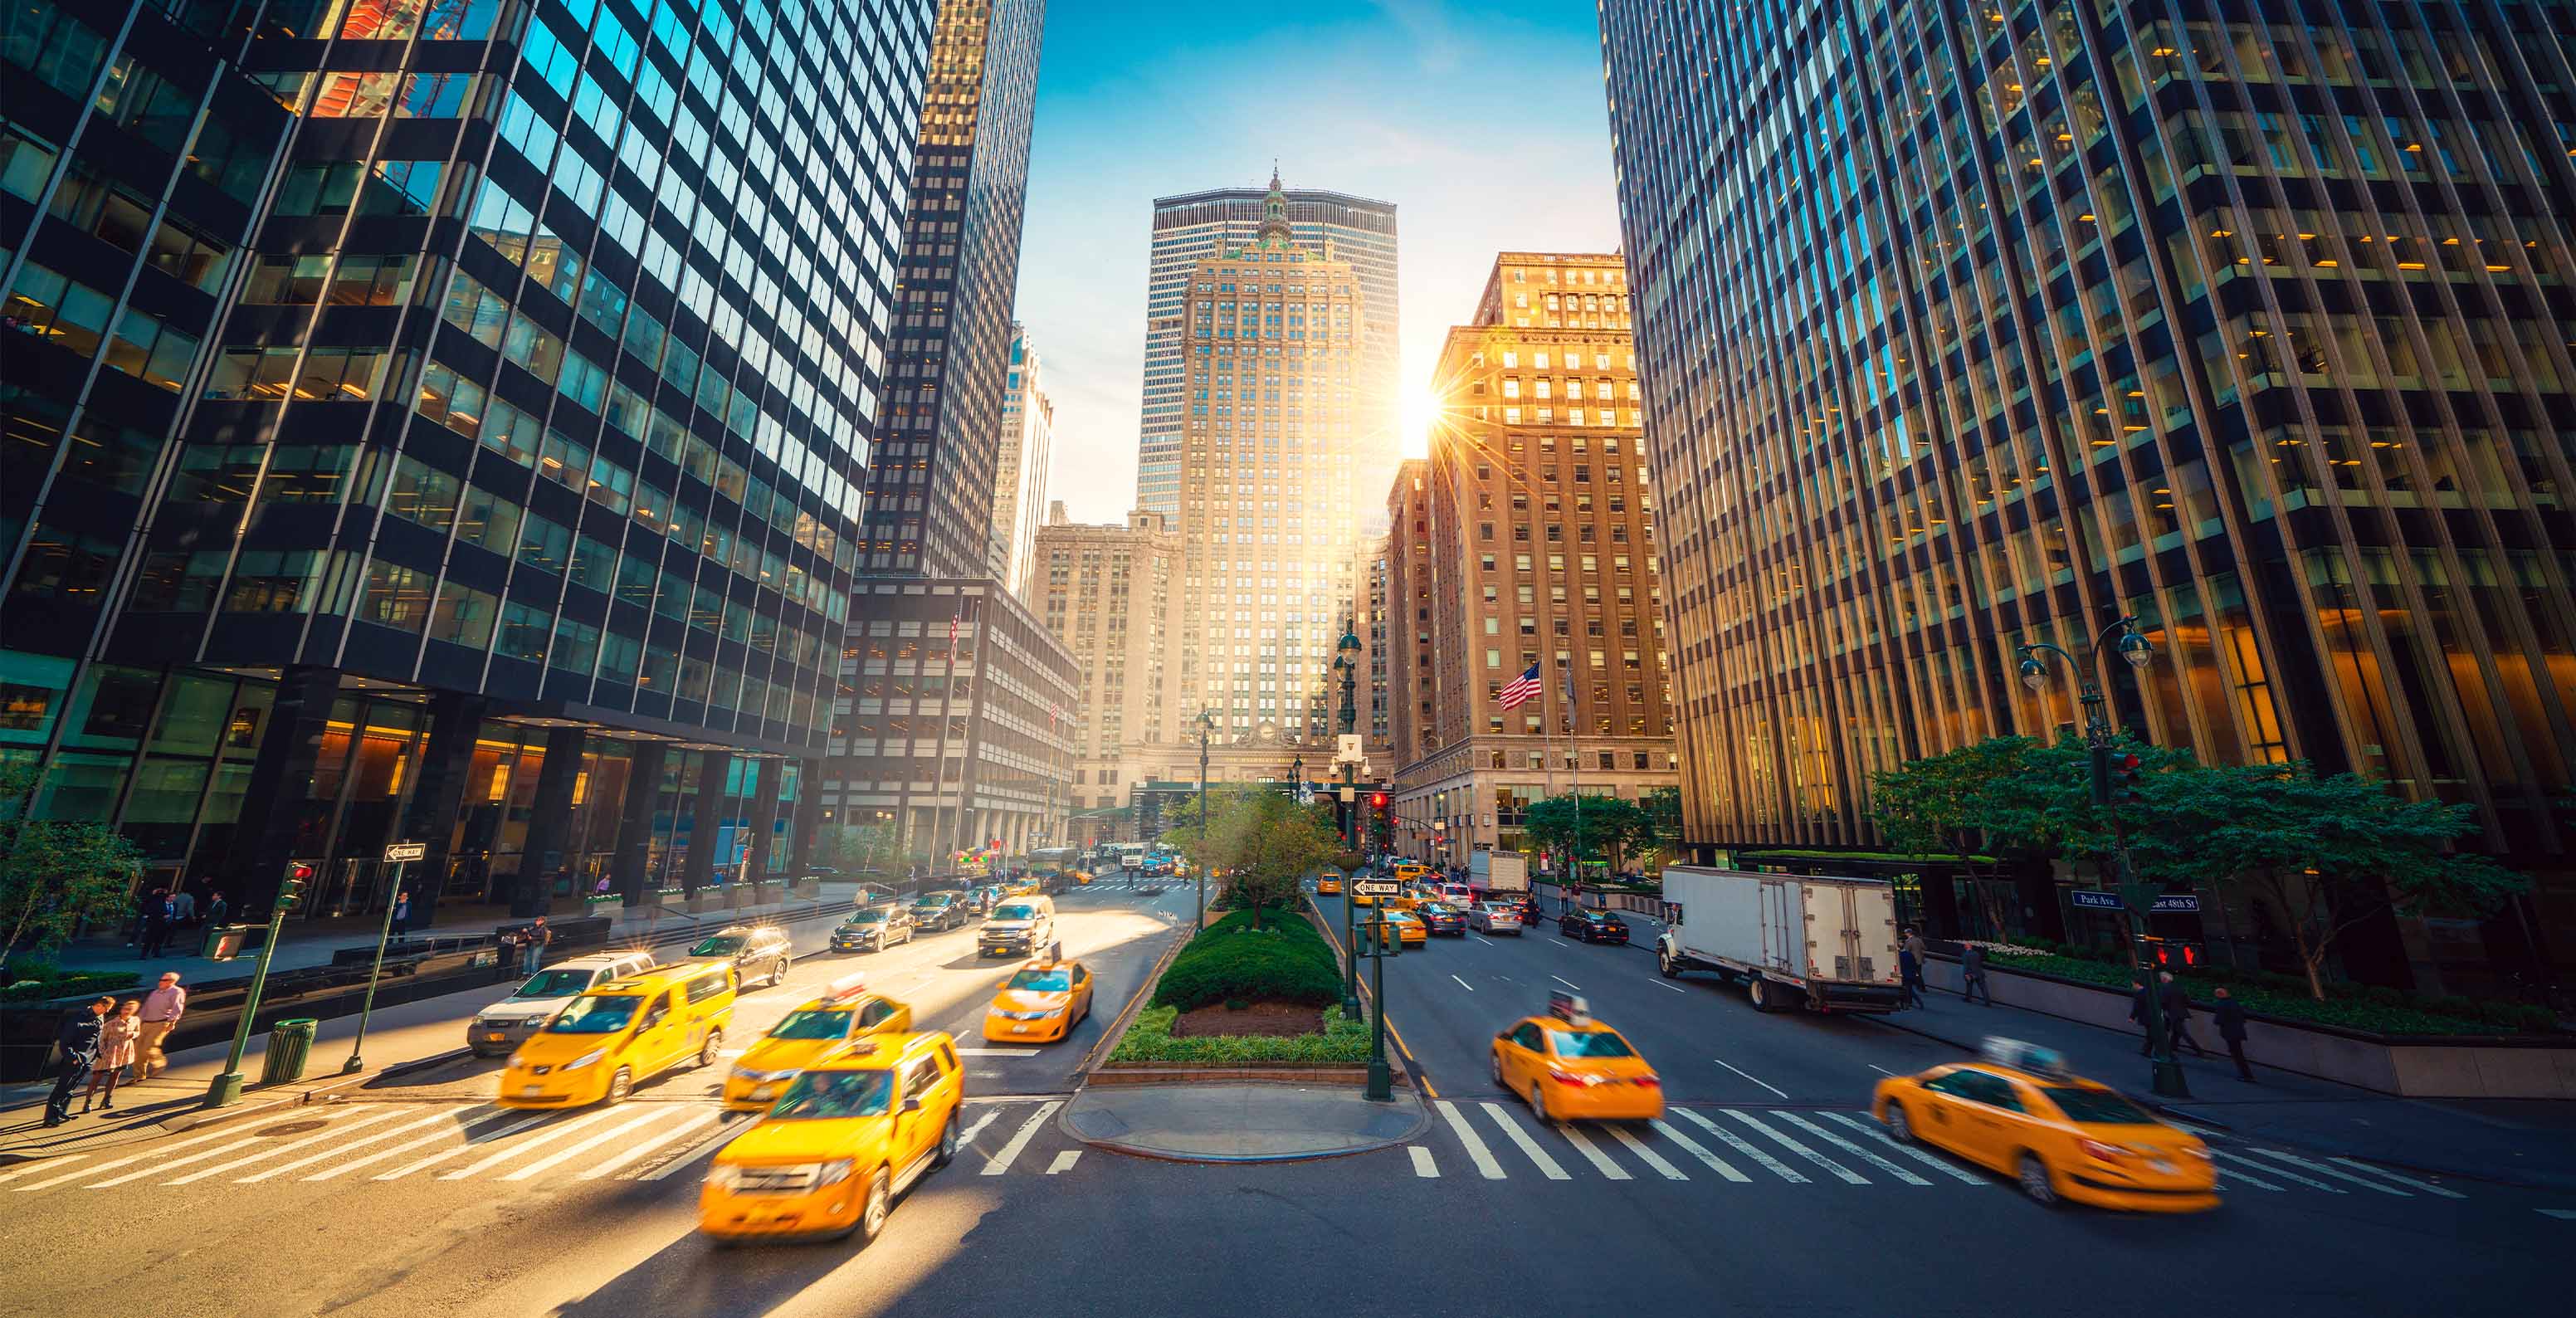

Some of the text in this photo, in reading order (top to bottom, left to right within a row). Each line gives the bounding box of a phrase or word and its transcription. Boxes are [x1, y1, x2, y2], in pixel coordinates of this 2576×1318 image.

[2081, 895, 2115, 906] Park Ave
[2168, 899, 2185, 908] 48th
[2185, 899, 2196, 909] St
